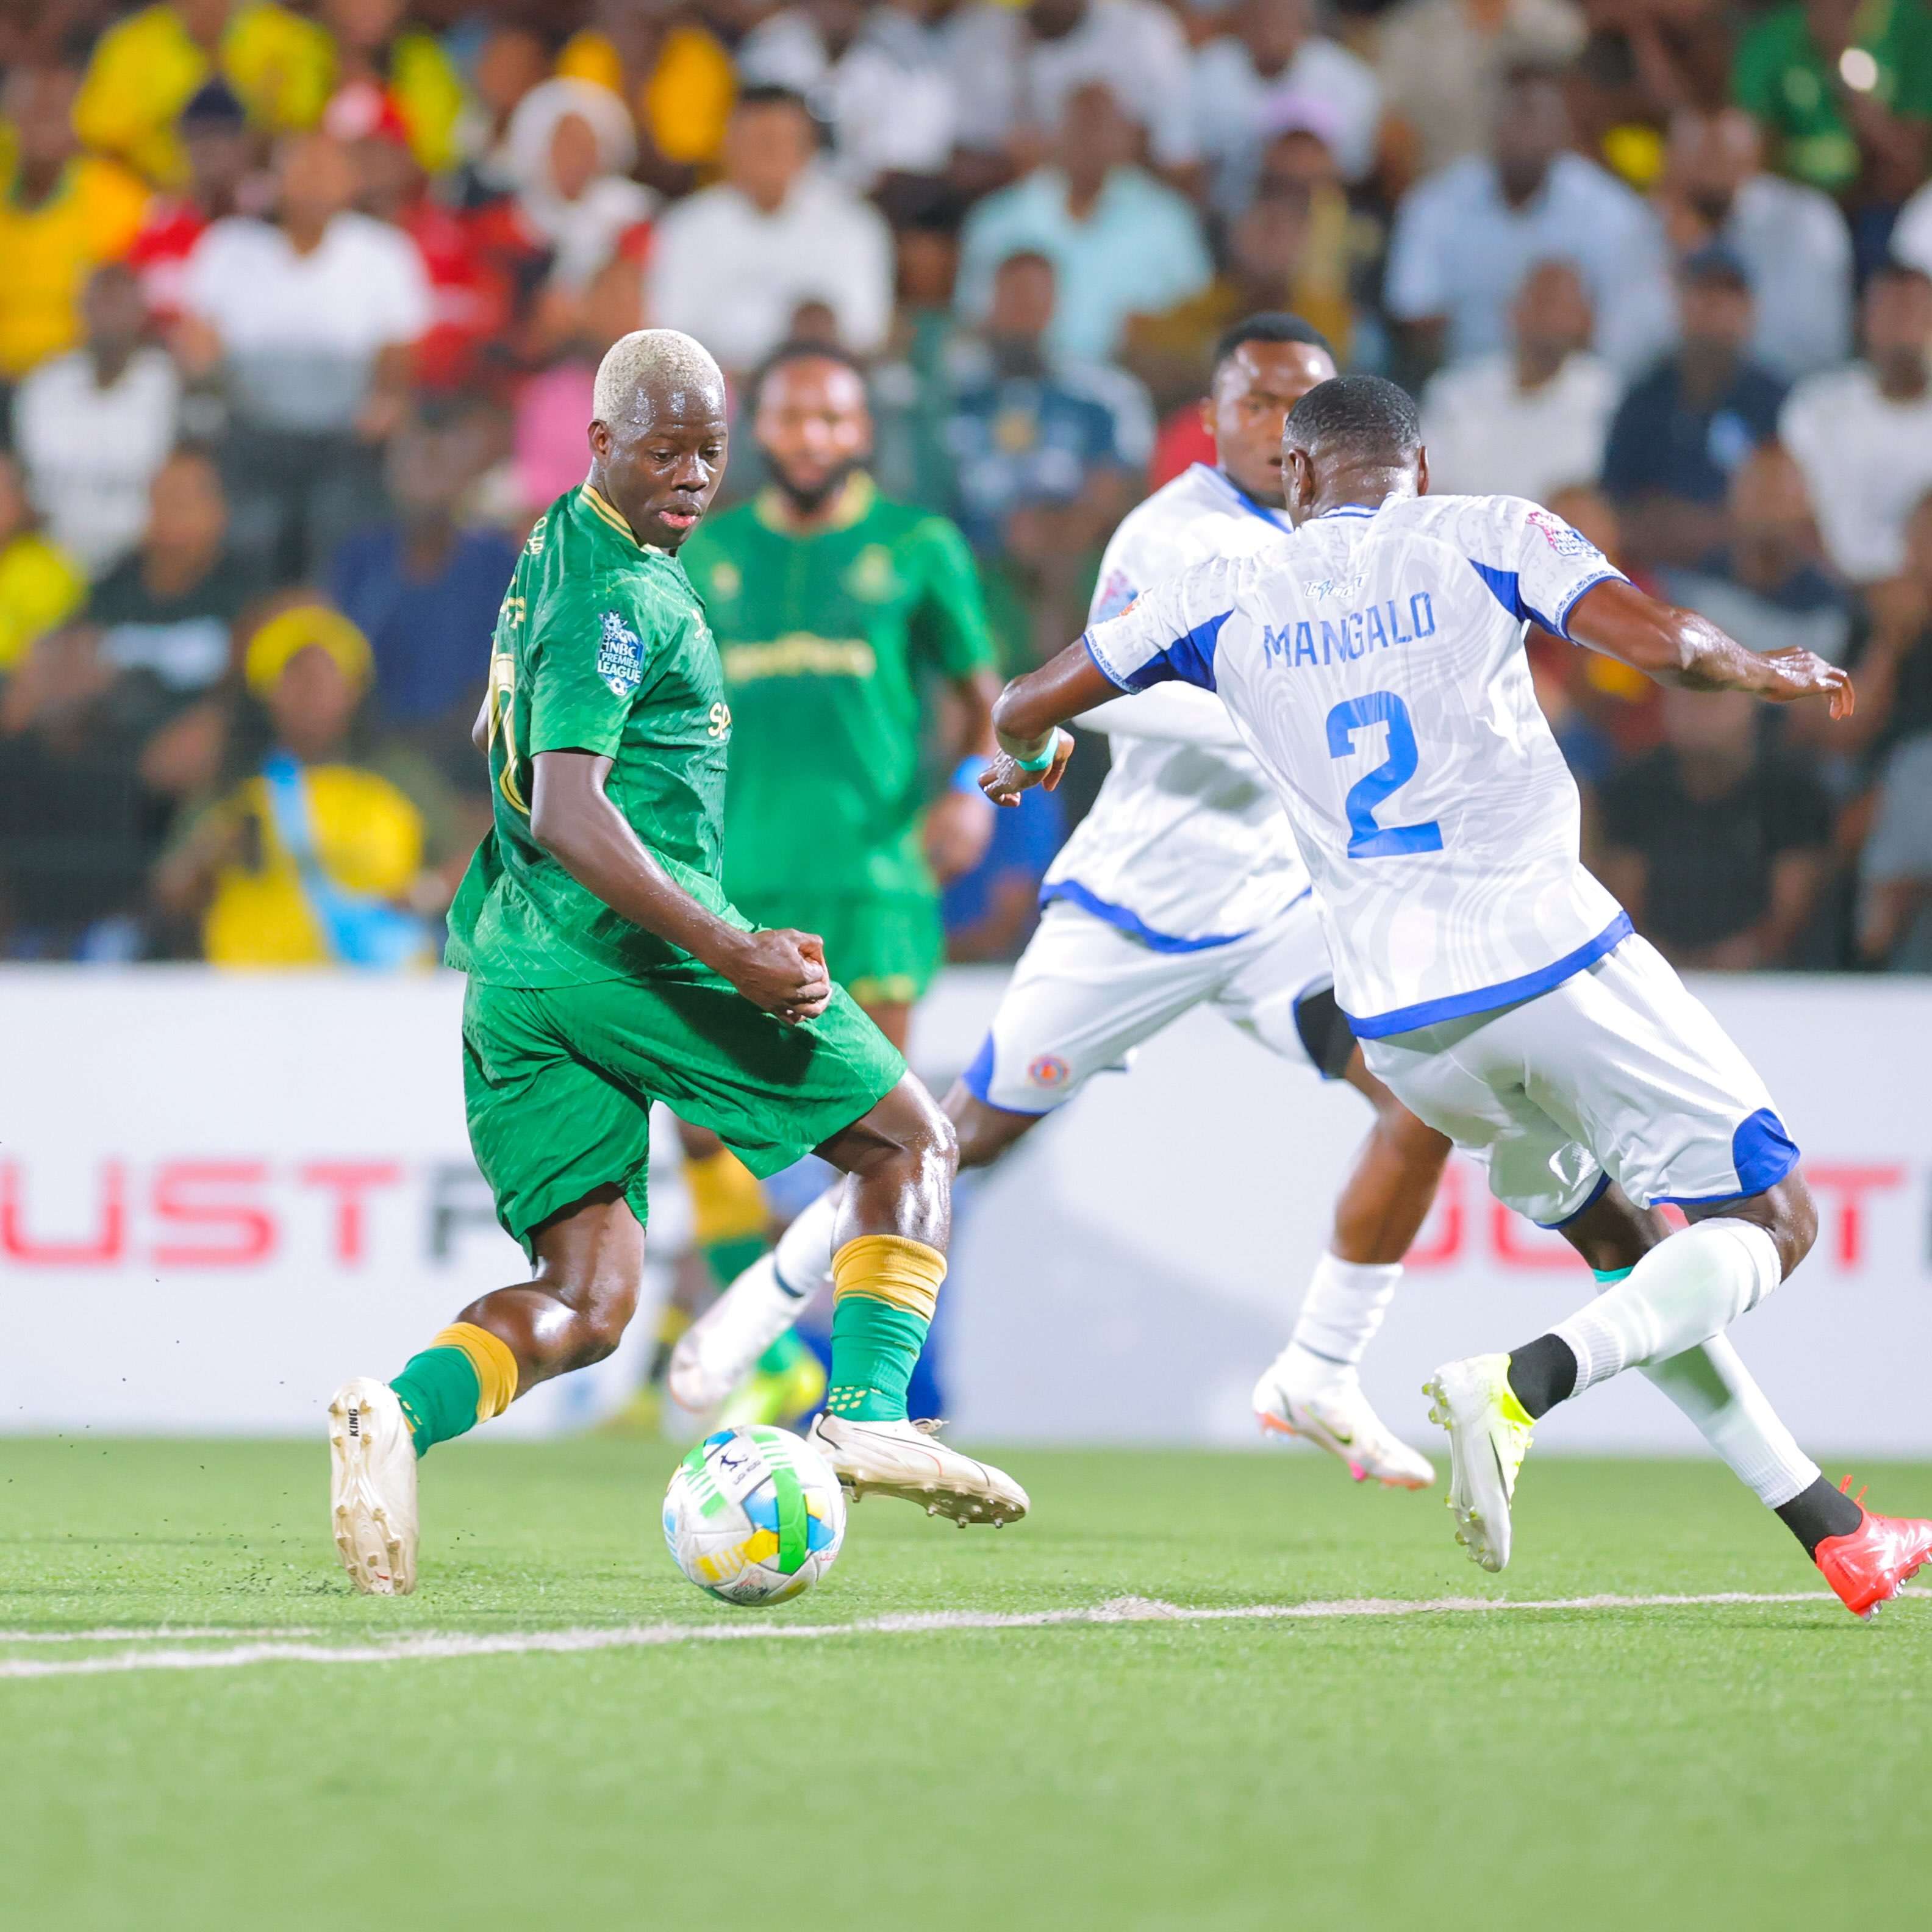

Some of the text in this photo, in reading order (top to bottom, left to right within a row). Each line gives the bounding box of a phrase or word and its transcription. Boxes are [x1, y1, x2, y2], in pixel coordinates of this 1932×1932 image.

[1263, 591, 1436, 670] MANGALO
[598, 660, 642, 684] LEAGUE
[601, 652, 640, 669] PREMIER
[1326, 690, 1444, 859] 2
[348, 1409, 359, 1437] KING
